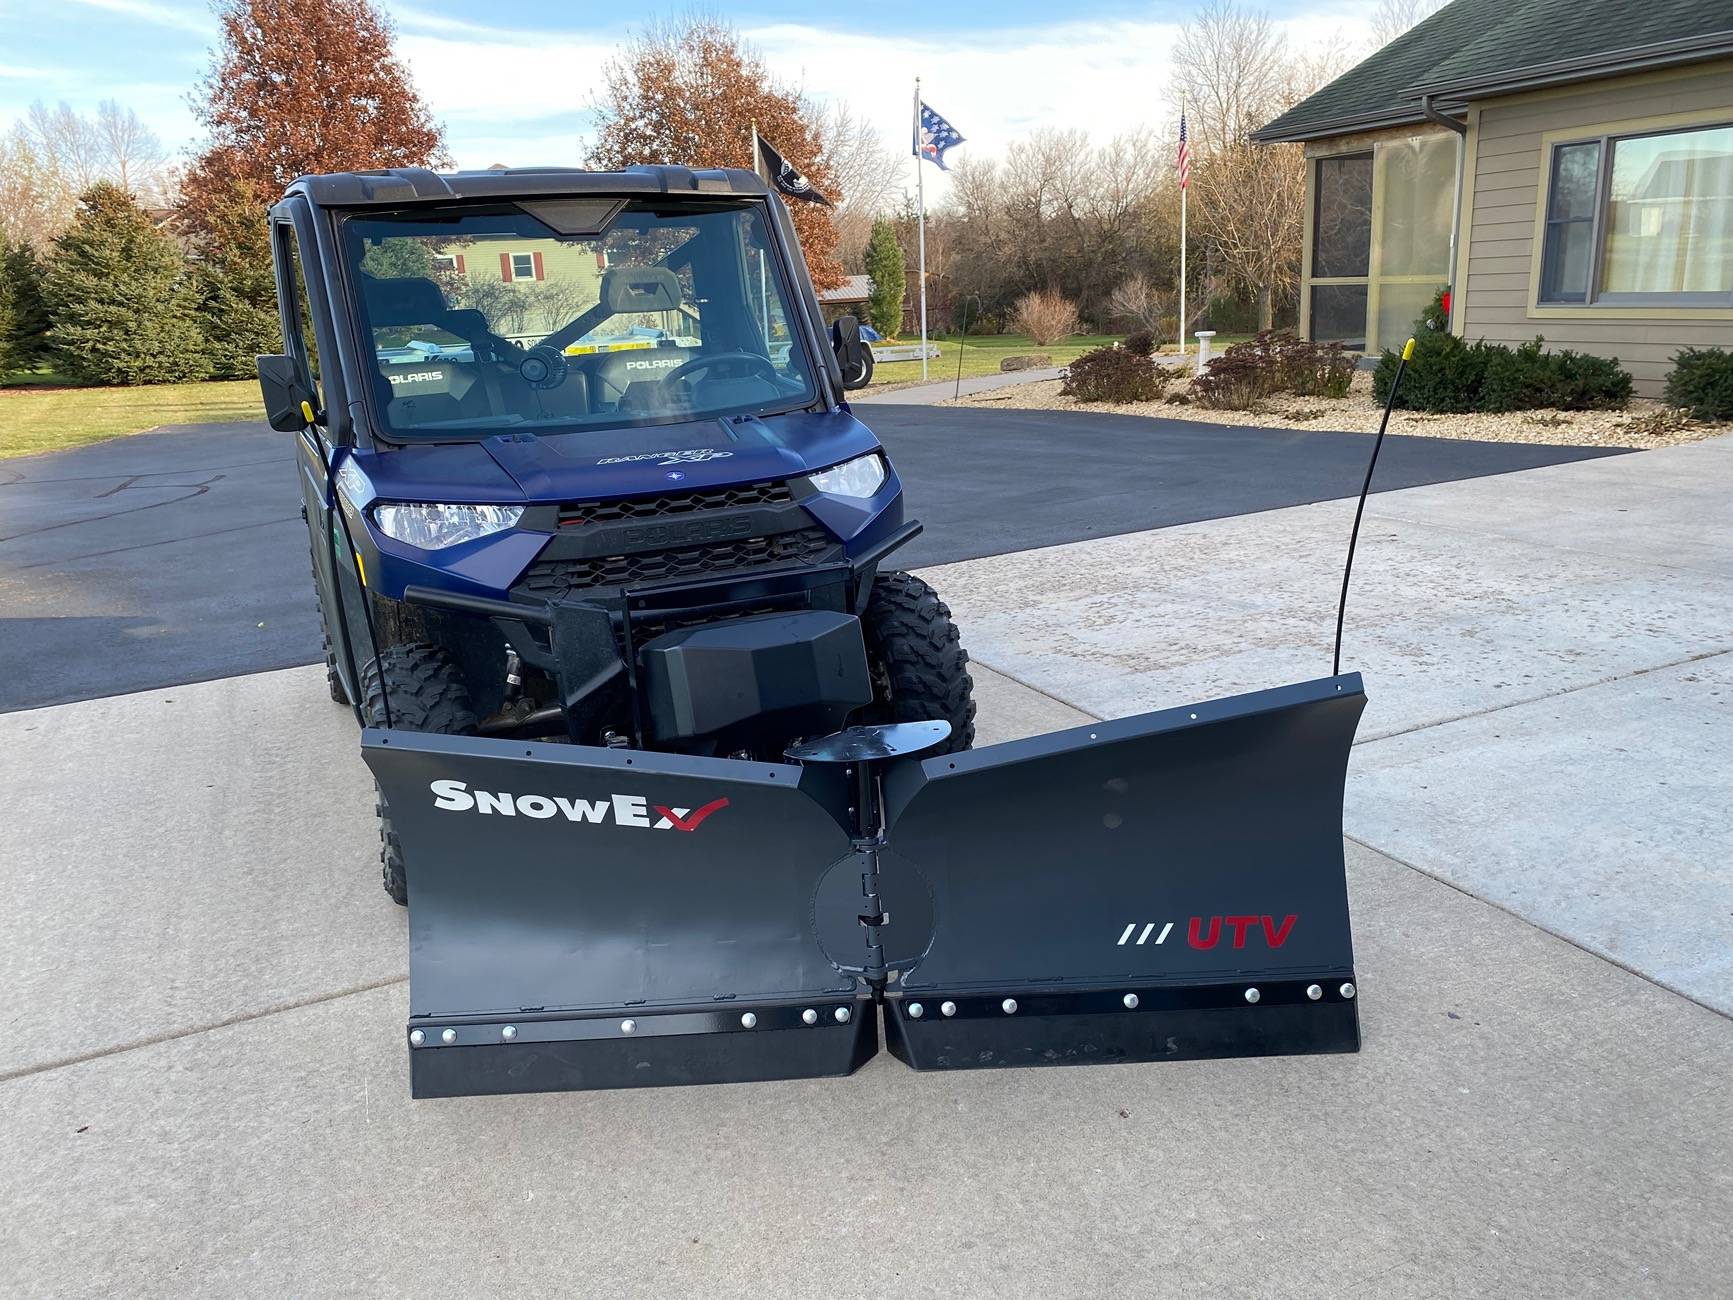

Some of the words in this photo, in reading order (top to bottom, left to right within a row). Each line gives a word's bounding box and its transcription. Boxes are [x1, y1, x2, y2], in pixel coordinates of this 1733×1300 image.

[626, 359, 683, 370] POLARIS
[388, 371, 443, 385] OLARIS
[597, 448, 714, 465] RANGER
[623, 514, 752, 546] POLARIS
[1187, 914, 1298, 951] UTV
